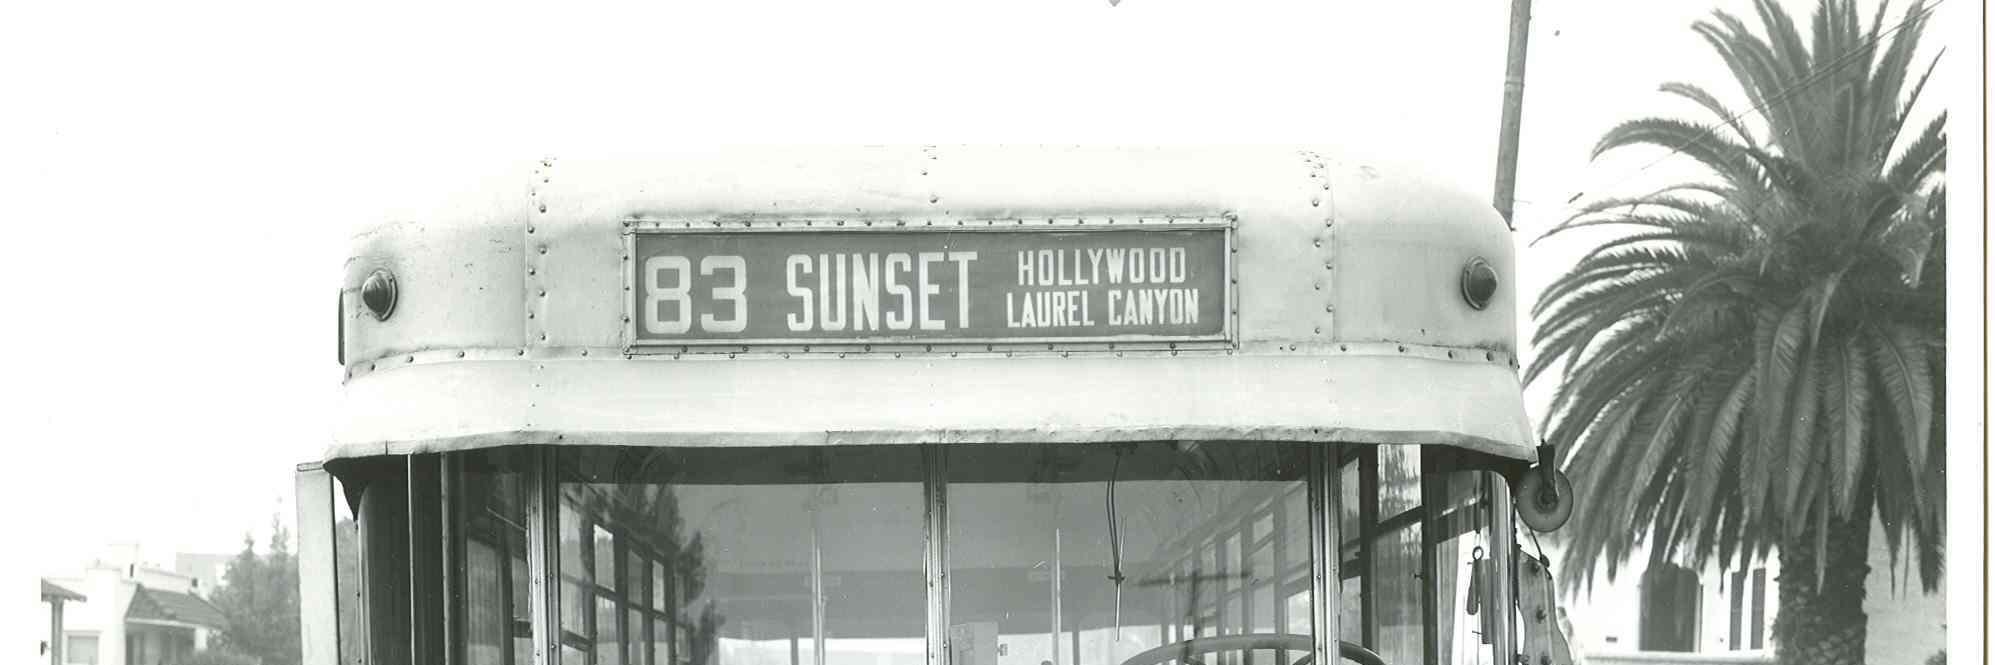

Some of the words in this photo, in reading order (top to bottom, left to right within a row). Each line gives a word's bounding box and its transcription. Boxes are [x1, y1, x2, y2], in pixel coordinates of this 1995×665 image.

[1018, 247, 1187, 287] HOLLYWOOD
[644, 255, 748, 335] 83
[786, 251, 979, 332] SUNSET
[1006, 290, 1095, 329] LAUREL
[1108, 287, 1200, 327] CANYON
